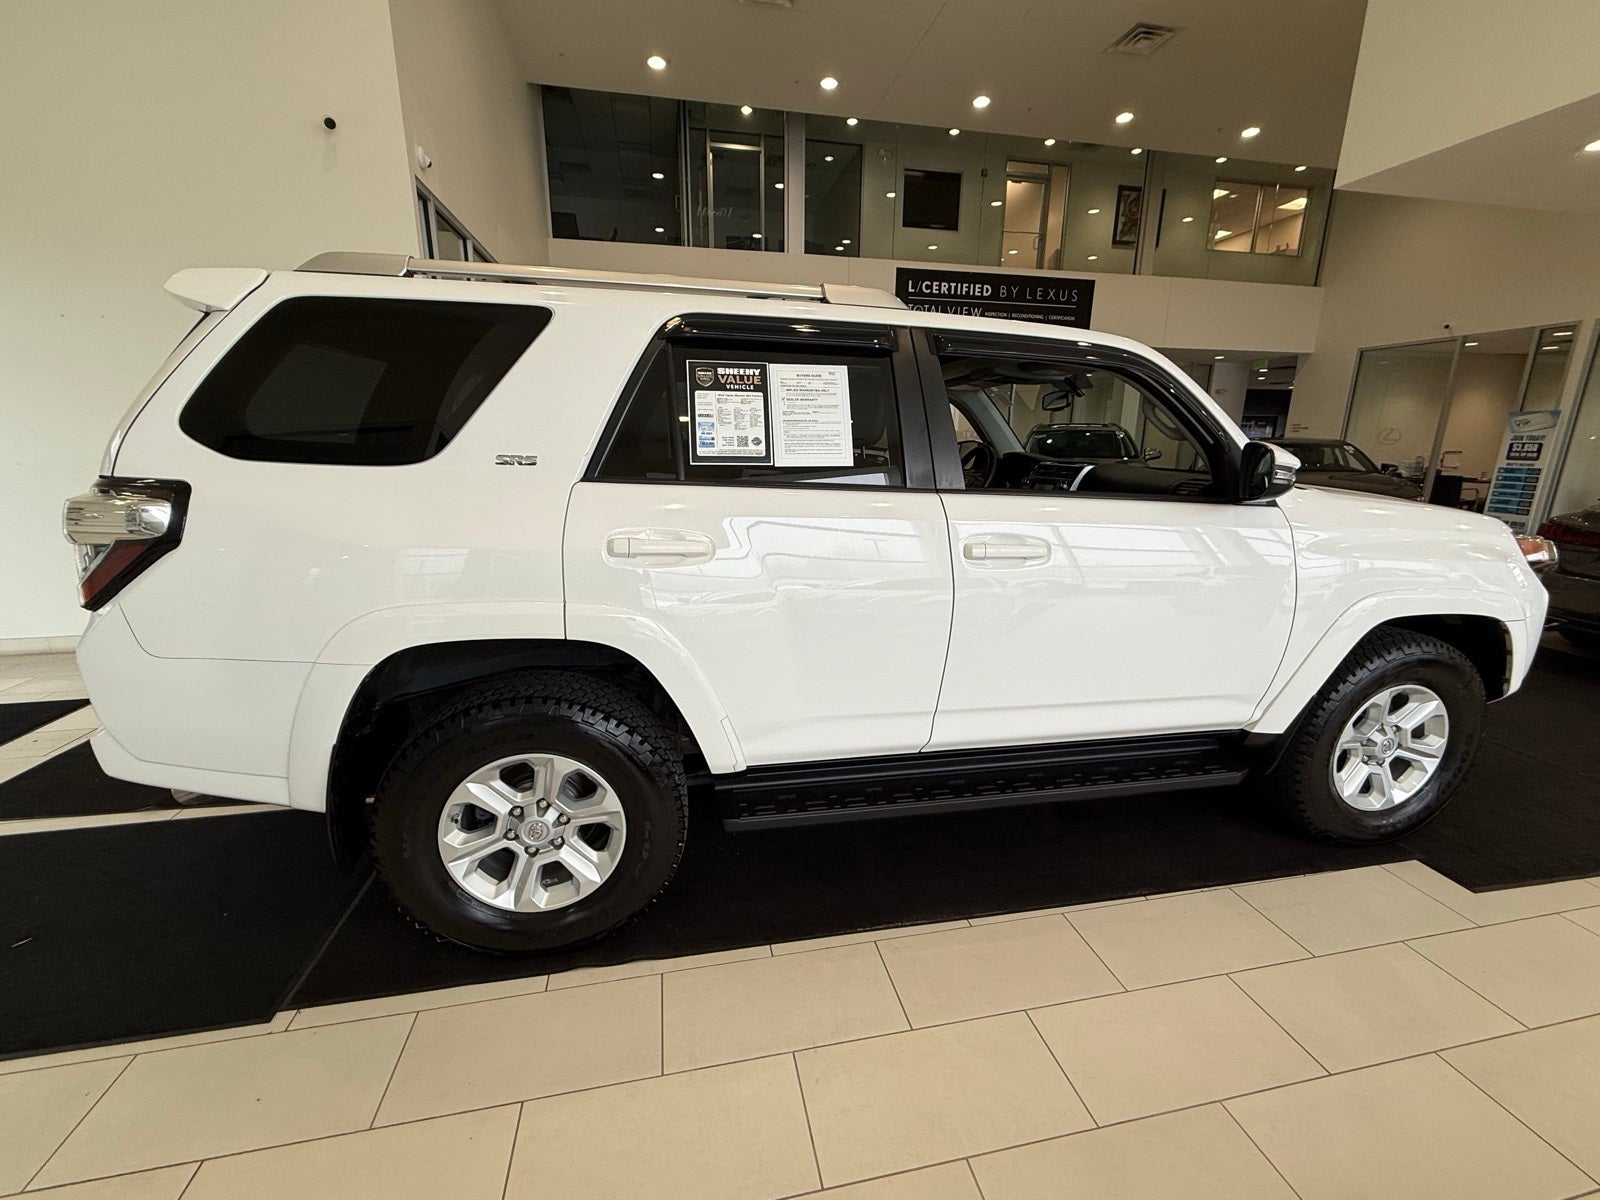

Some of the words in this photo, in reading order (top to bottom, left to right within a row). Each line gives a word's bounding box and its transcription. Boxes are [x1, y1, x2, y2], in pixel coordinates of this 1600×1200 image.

[908, 280, 992, 297] L/CERTIFIED
[1000, 286, 1019, 298] BY
[1026, 287, 1078, 302] LEXUS
[908, 303, 942, 314] TOTAL
[947, 307, 982, 317] VIEW
[717, 367, 761, 375] SHEEHY
[717, 374, 762, 385] VALUE
